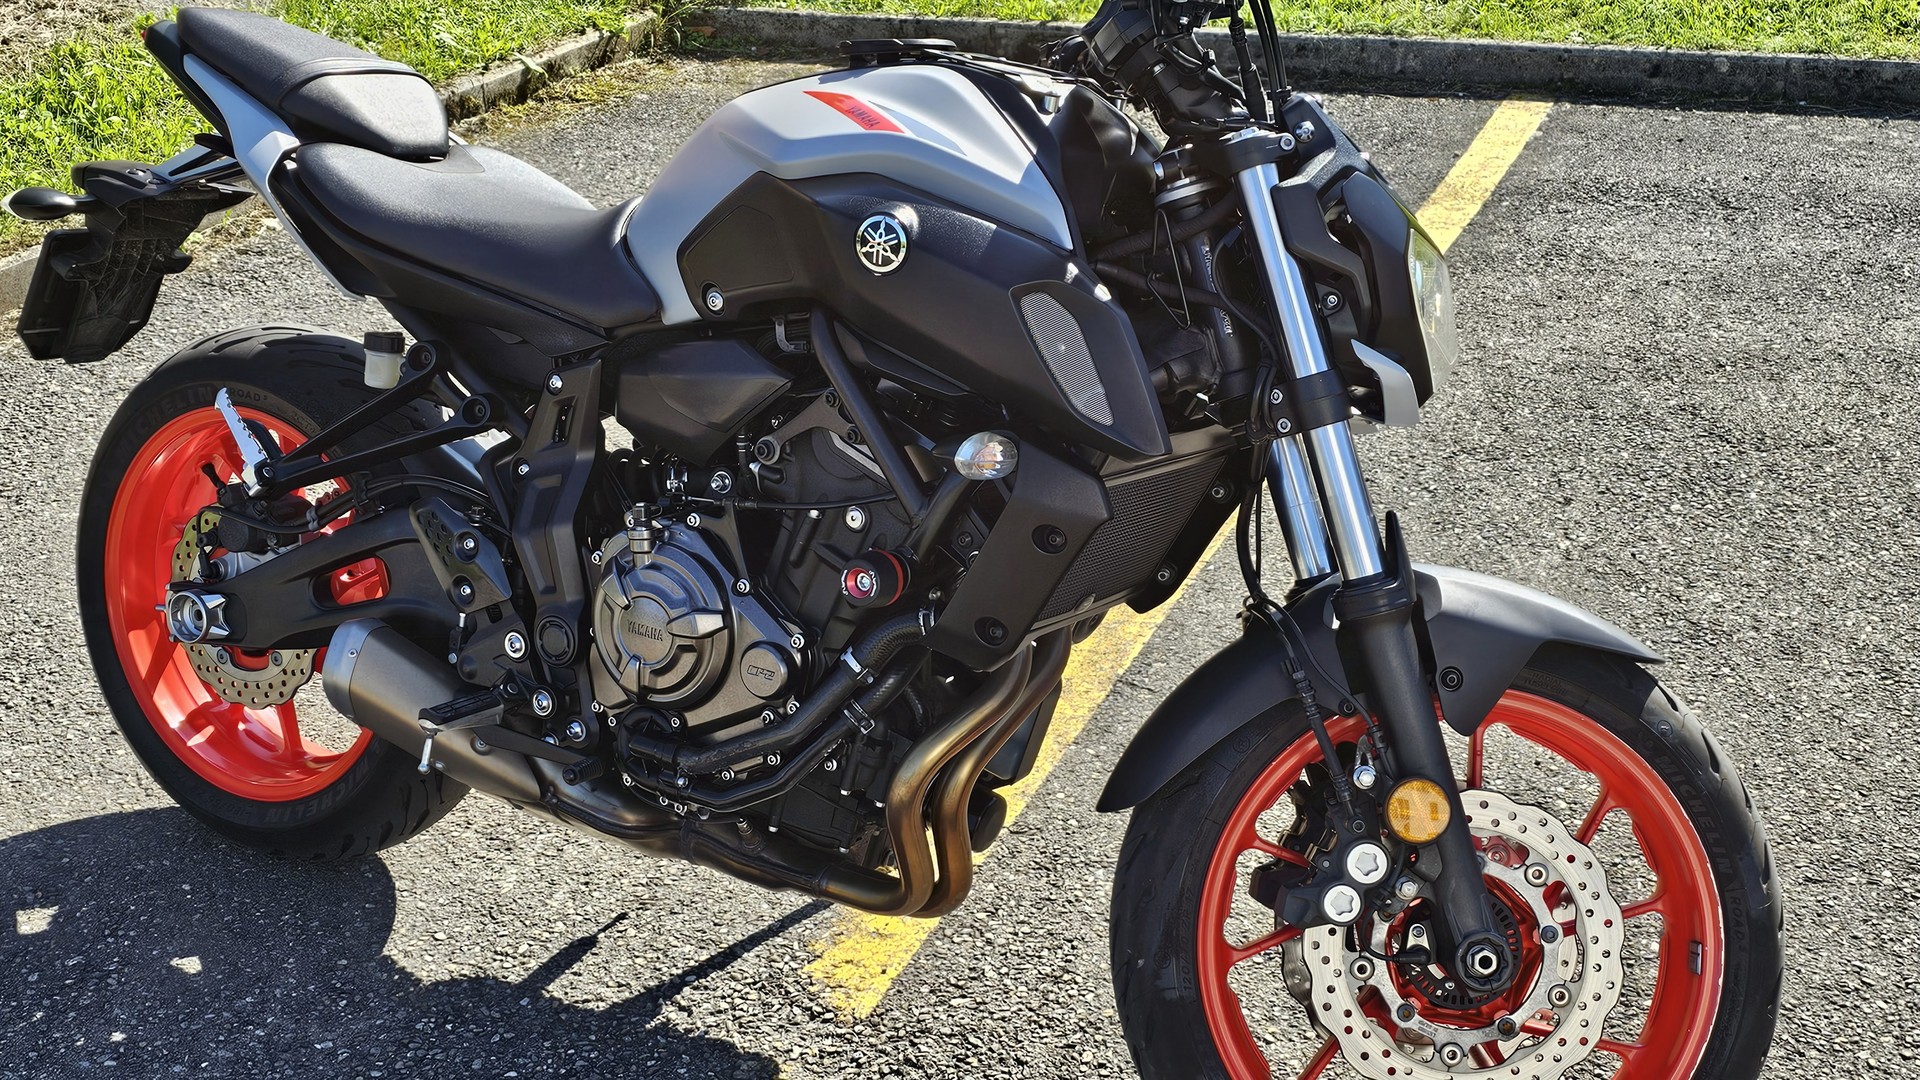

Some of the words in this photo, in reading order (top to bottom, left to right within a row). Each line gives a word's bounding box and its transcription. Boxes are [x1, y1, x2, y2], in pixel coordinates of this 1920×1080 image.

[845, 106, 880, 128] YAMAHA
[230, 387, 261, 402] ROAD
[112, 385, 213, 460] MICHELIN
[627, 619, 663, 642] YAMAHA
[266, 756, 371, 823] MICHELIN
[1655, 754, 1733, 875] MICHELIN
[1729, 895, 1745, 941] ROAD
